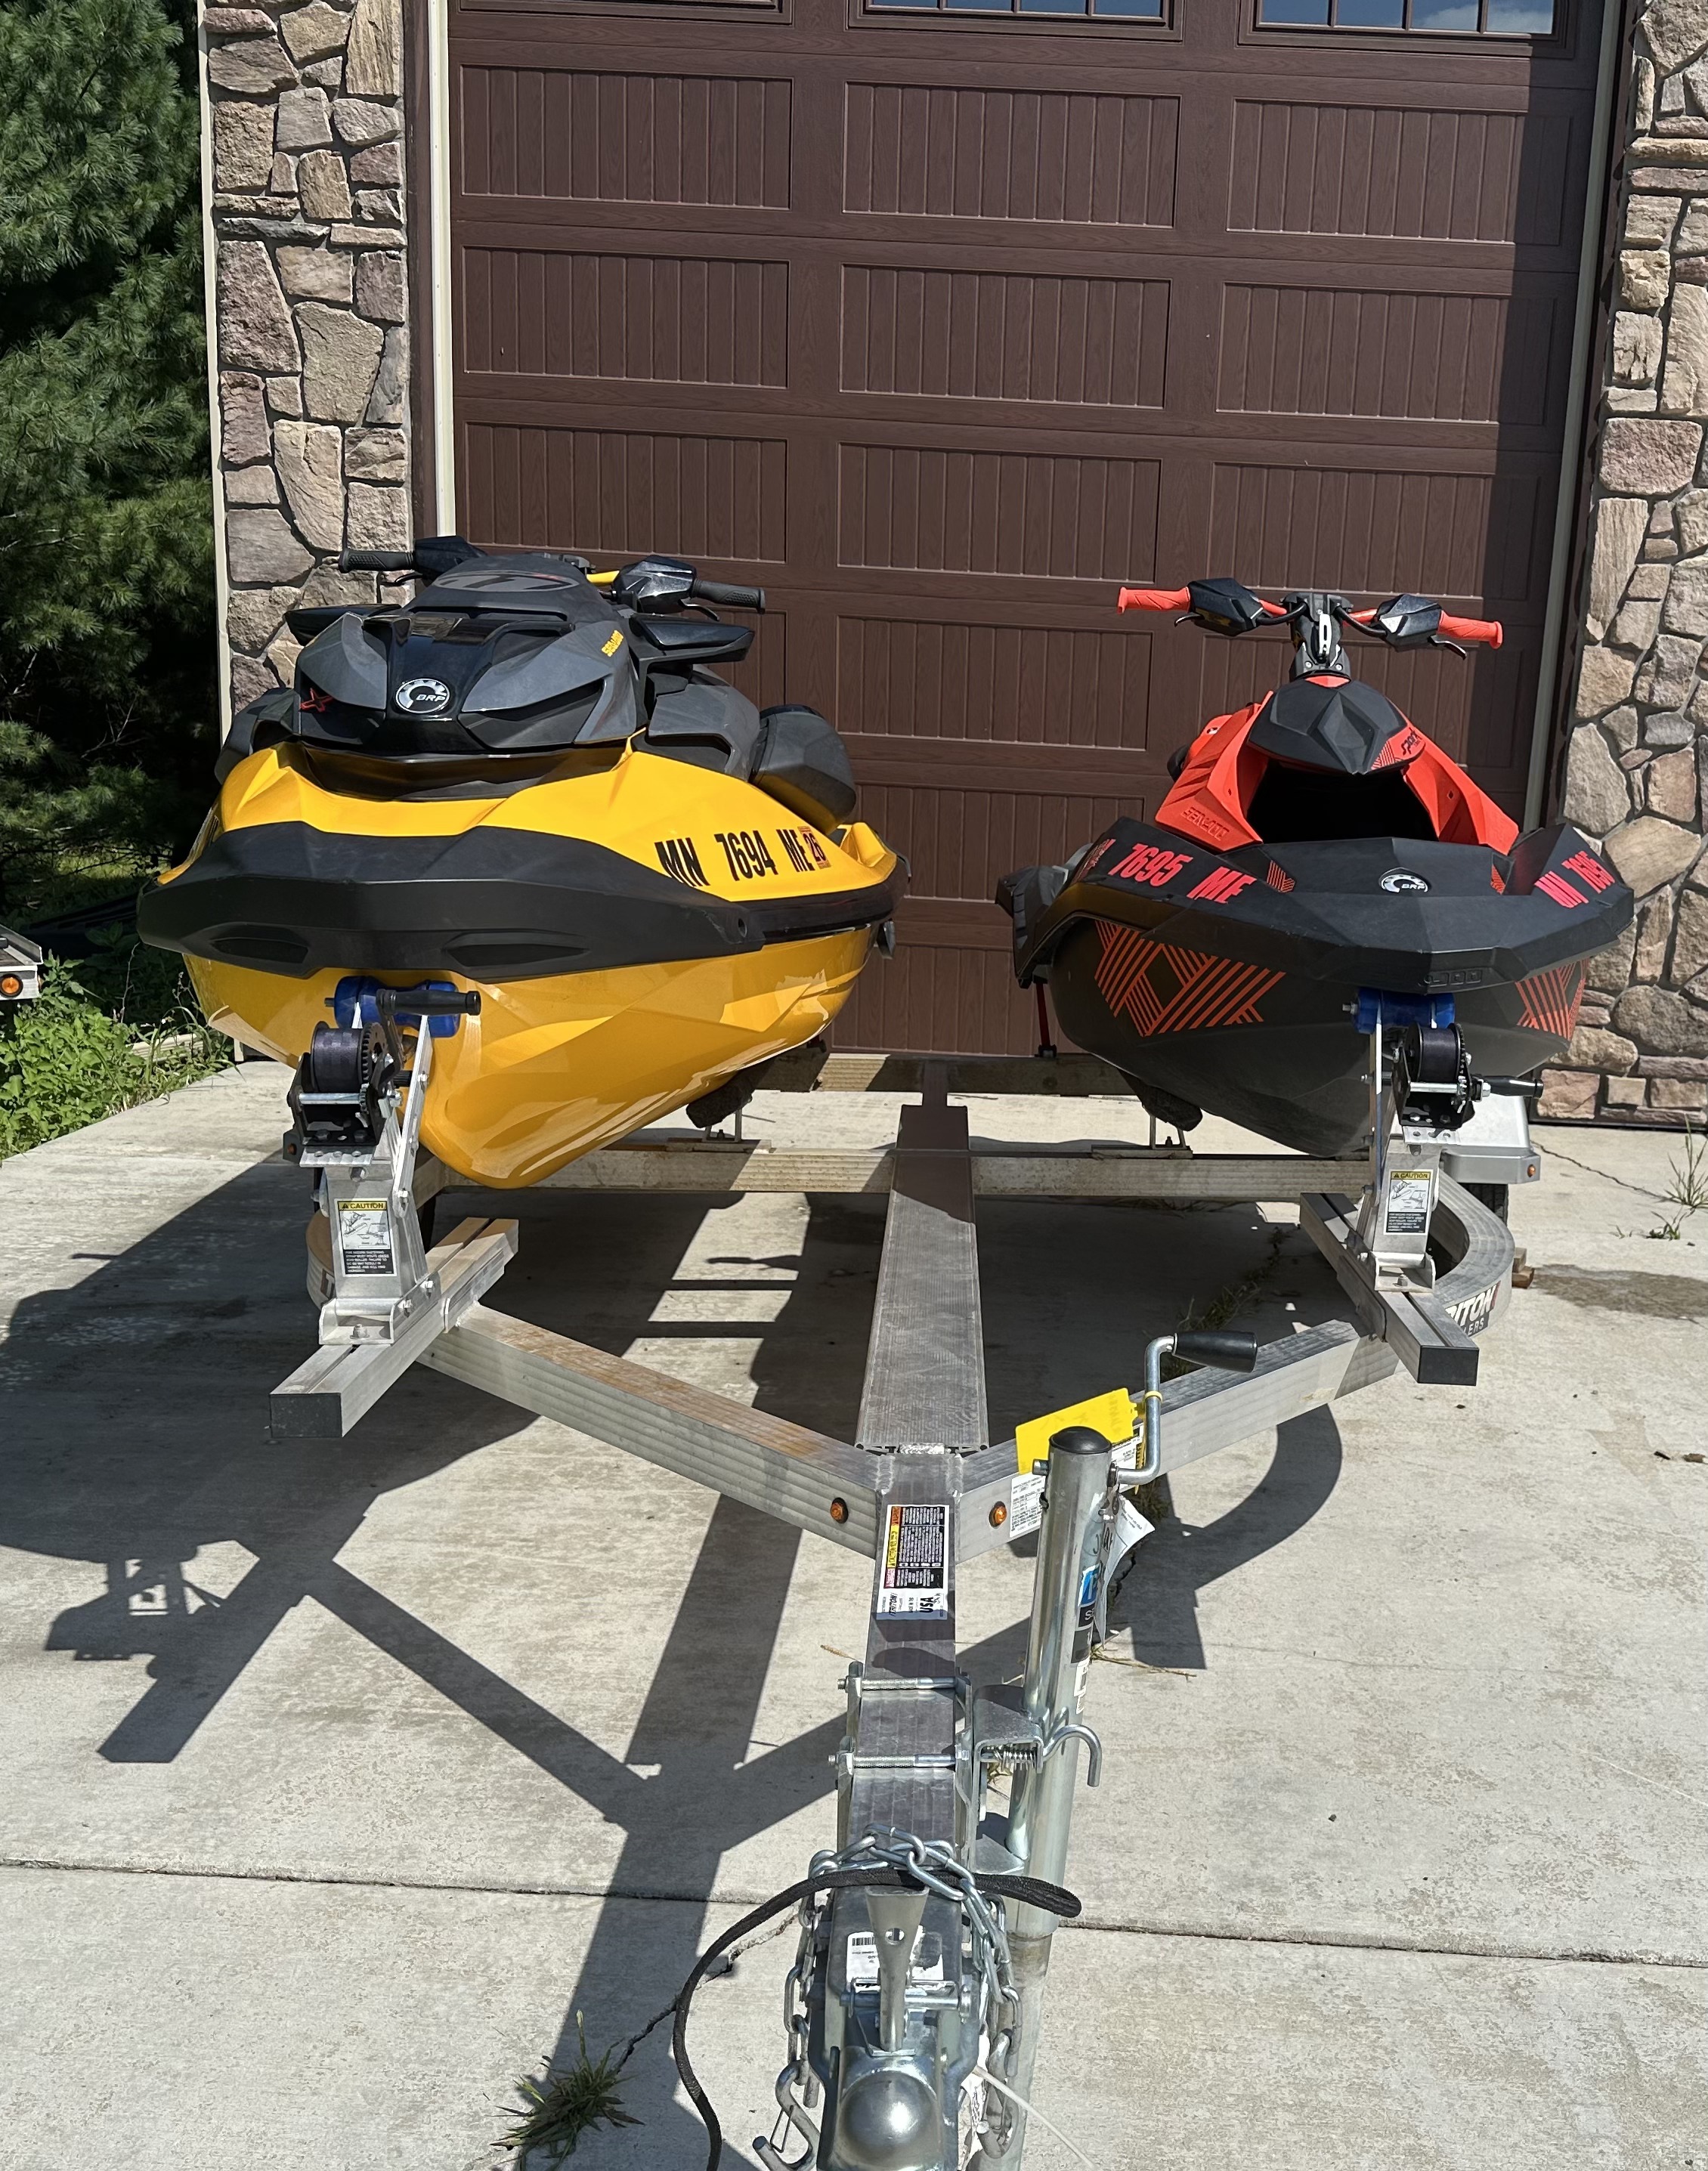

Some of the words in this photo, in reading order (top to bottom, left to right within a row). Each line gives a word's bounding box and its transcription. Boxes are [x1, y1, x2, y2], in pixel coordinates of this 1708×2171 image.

[416, 694, 446, 702] BRP
[654, 837, 711, 886] MN
[713, 830, 778, 882] 7694
[776, 829, 815, 872] ME
[1107, 843, 1194, 887] 7695
[920, 1597, 934, 1613] USA
